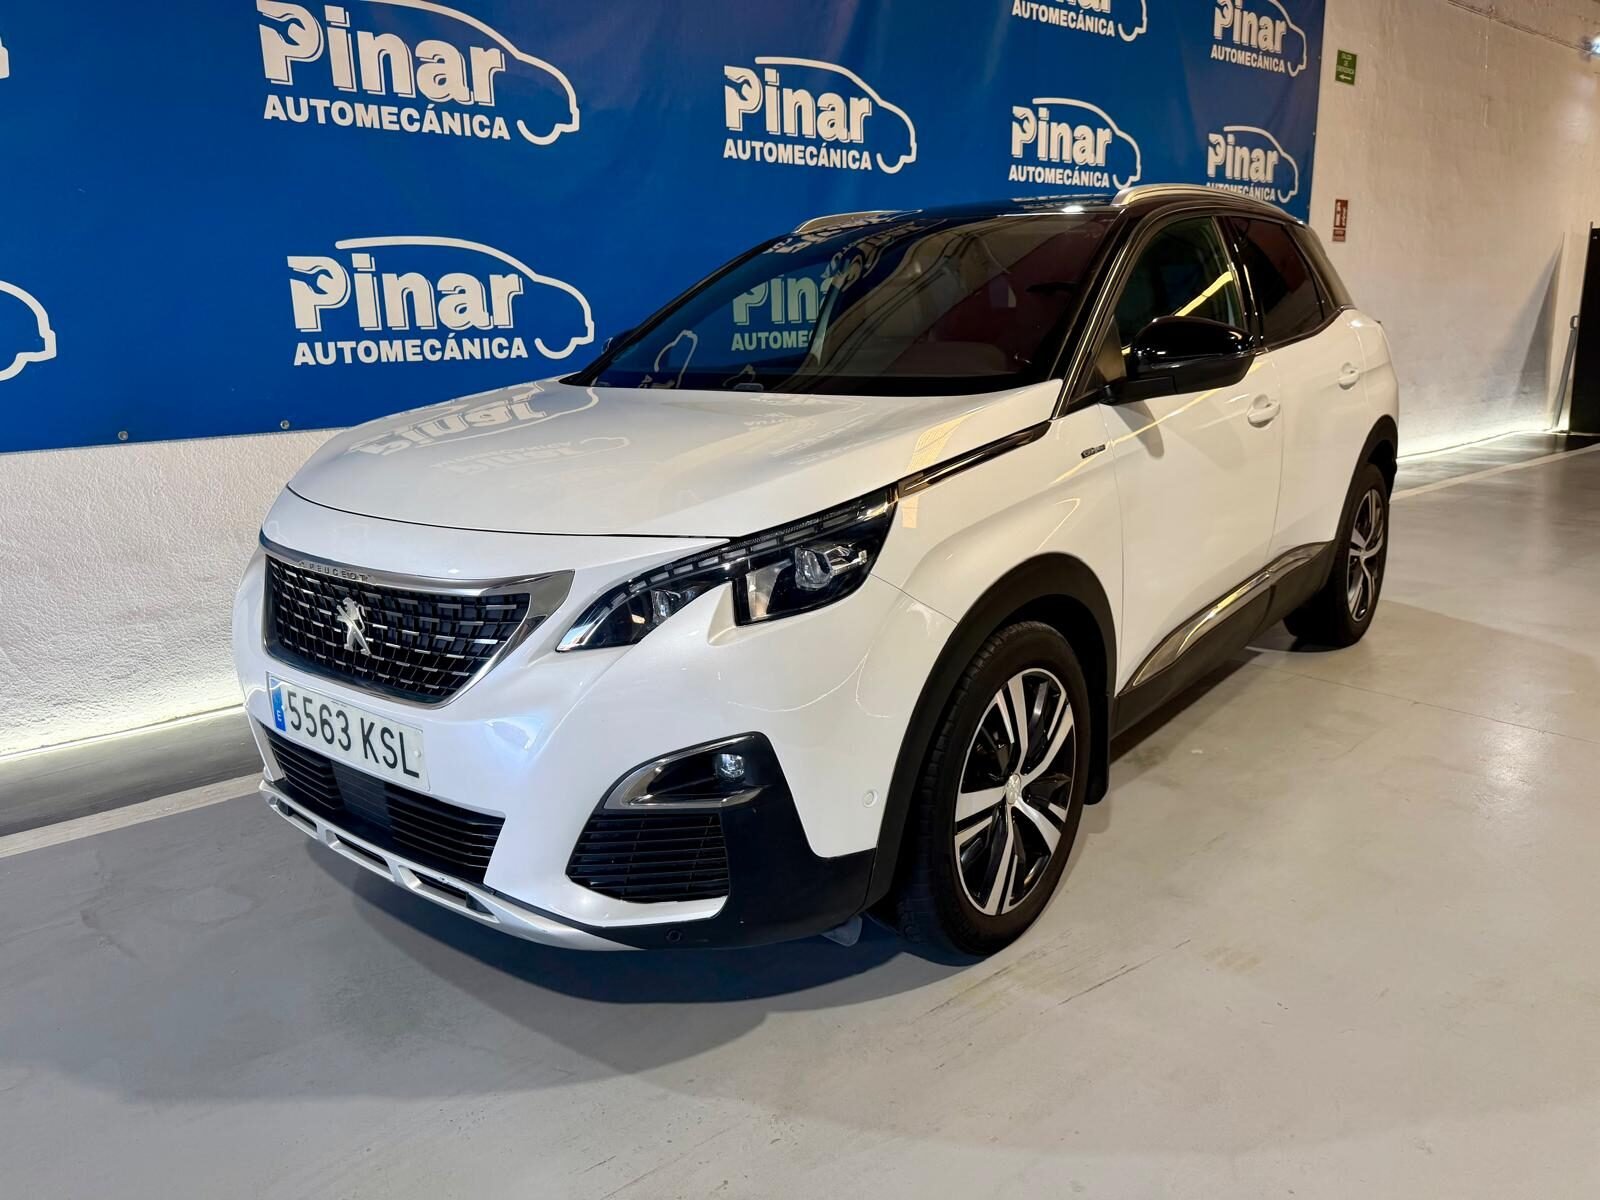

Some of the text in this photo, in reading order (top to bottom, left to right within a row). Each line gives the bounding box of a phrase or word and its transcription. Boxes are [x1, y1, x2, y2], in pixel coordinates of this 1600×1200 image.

[1011, 0, 1116, 37] AUTOMECÁNICA
[1213, 0, 1287, 54] Pinar
[256, 0, 506, 107] Pinar
[1210, 44, 1286, 73] AUTOMECÁNICA
[263, 94, 511, 140] AUTOMECÁNICA
[723, 65, 873, 144] Pinar
[723, 138, 873, 171] AUTOMECÁNICA
[1011, 105, 1113, 167] Pinar
[1207, 133, 1278, 184] Pinar
[1008, 165, 1110, 188] AUTOMECÁNICA
[287, 253, 523, 332] Pinar
[293, 332, 529, 366] AUTOMECÁNICA
[731, 330, 813, 351] AUTOME
[276, 710, 283, 722] E
[286, 690, 420, 779] 5563 KSL
